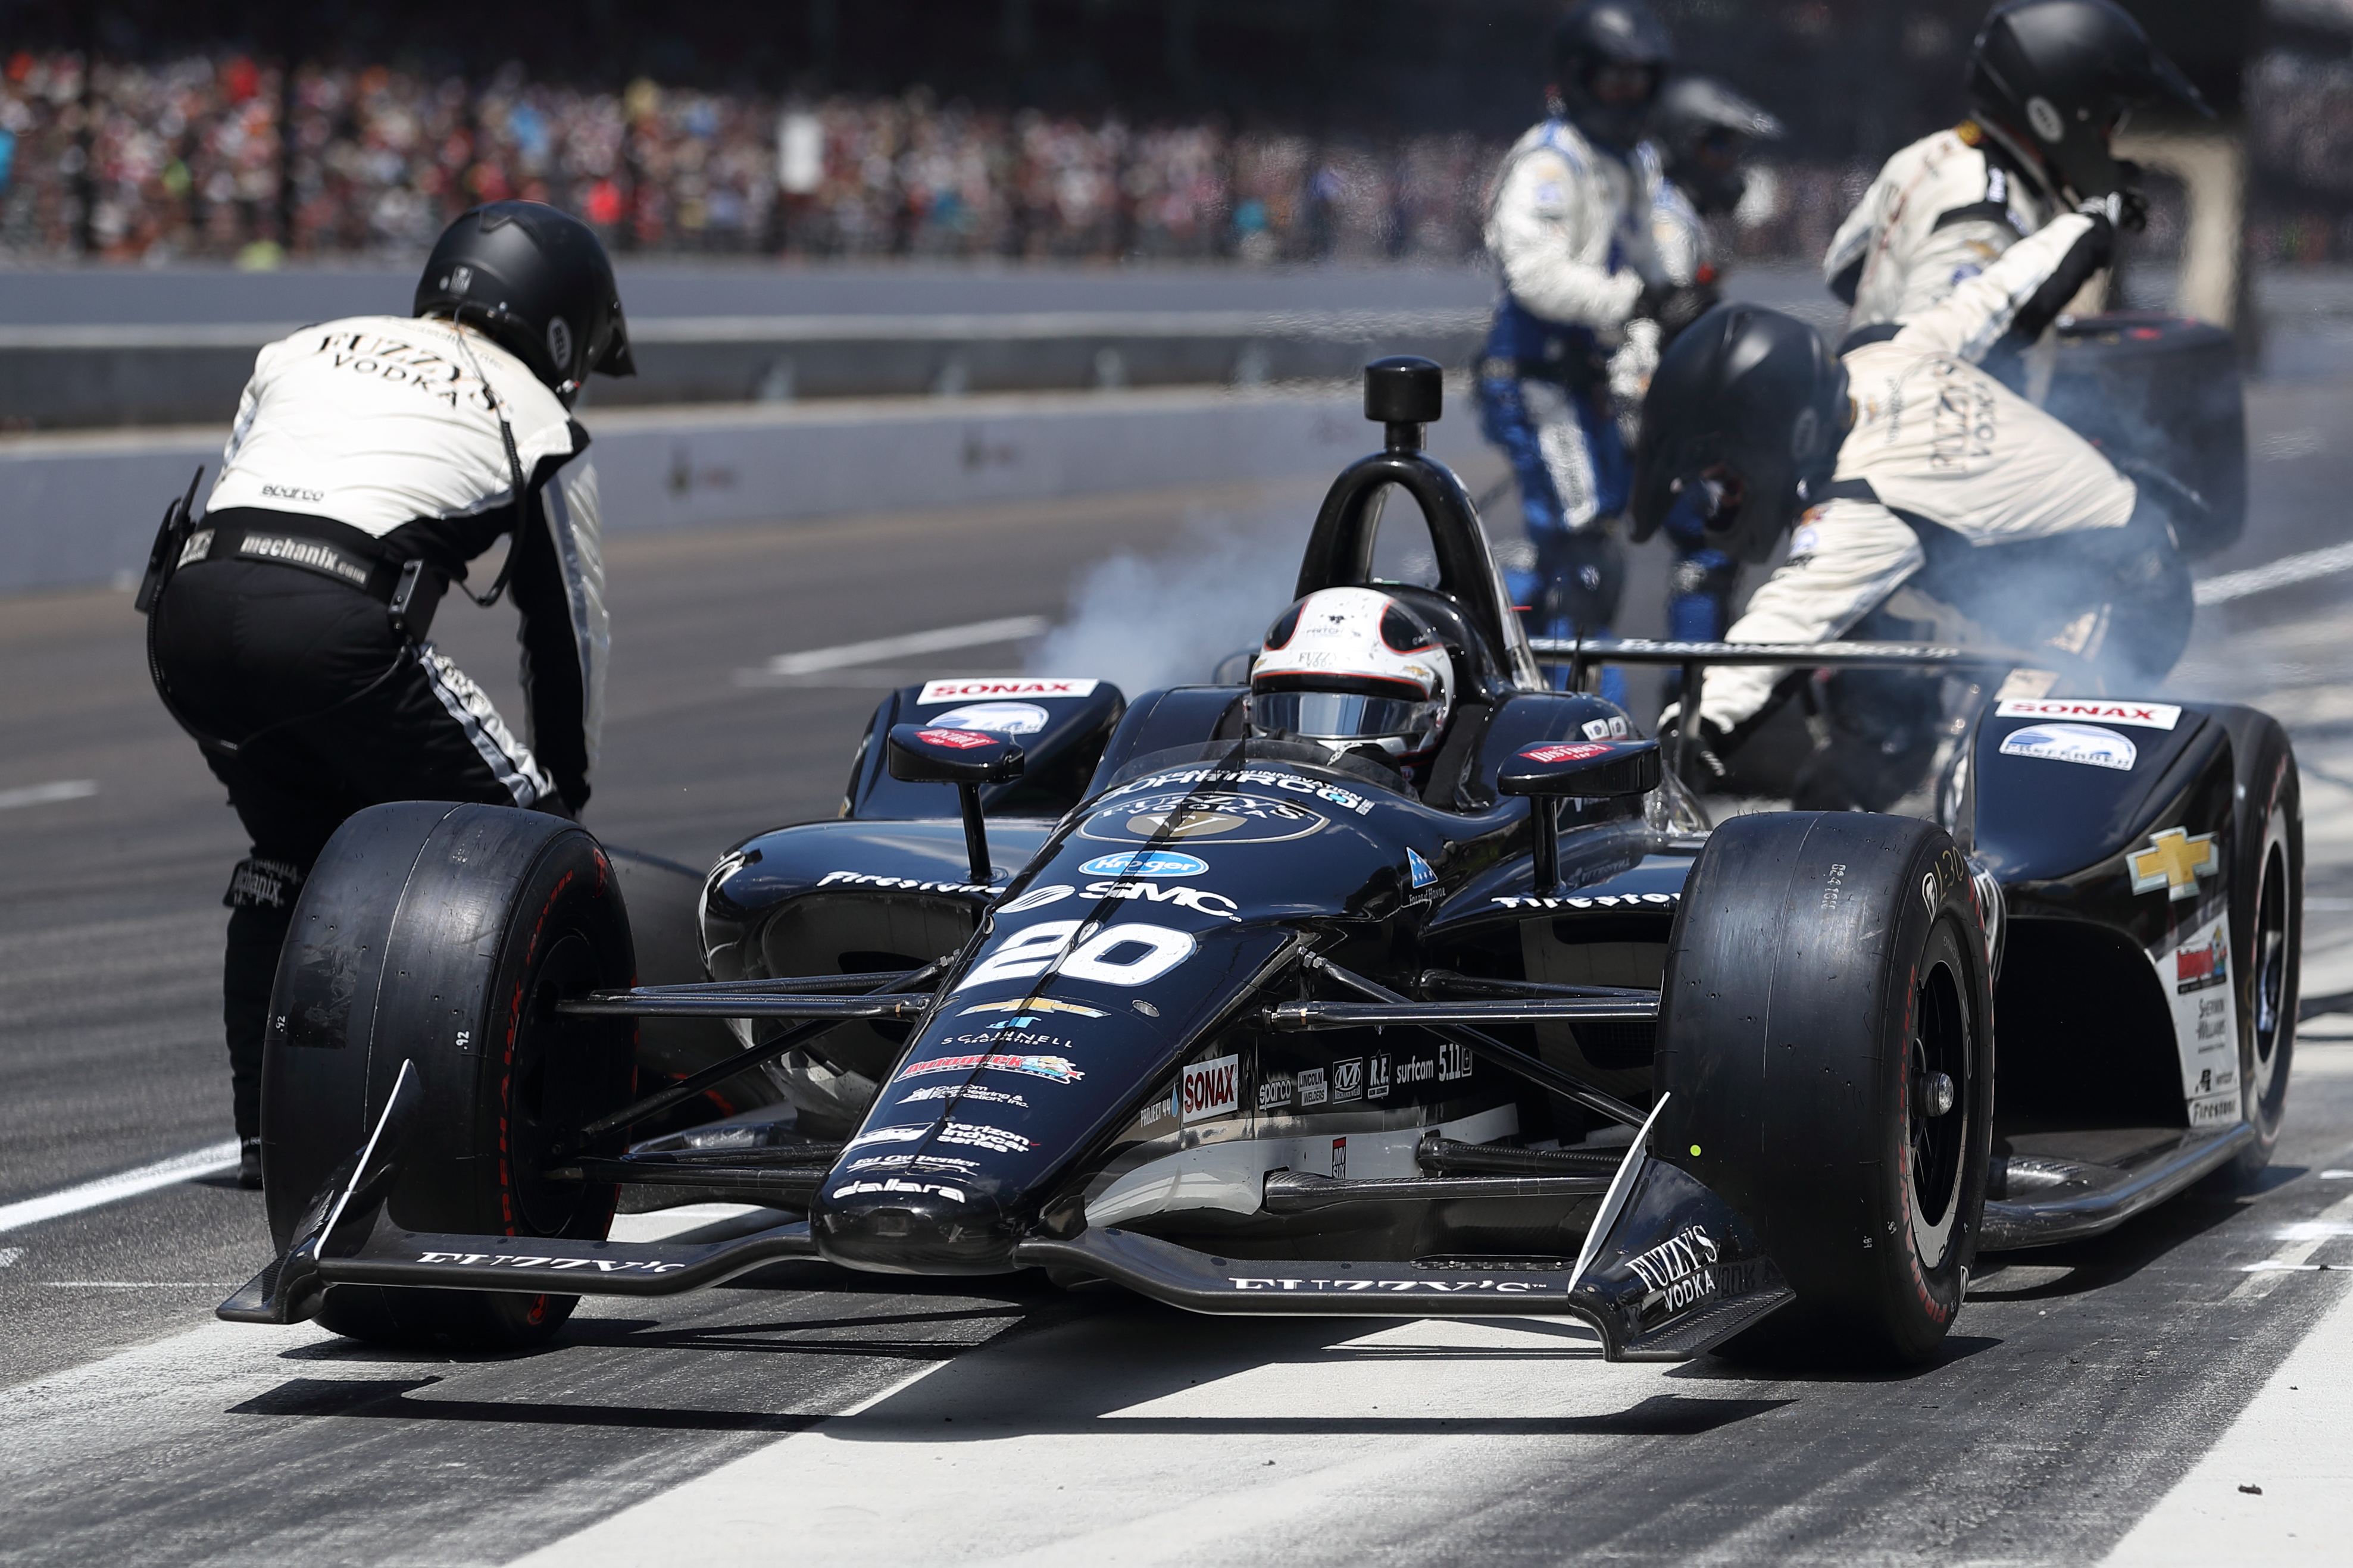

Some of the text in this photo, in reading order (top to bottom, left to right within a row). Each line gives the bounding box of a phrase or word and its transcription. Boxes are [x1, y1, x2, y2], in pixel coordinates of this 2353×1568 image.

[332, 353, 457, 409] VODKA
[261, 484, 324, 502] sparco
[932, 683, 1074, 696] SONAX
[2011, 703, 2158, 720] SONAX
[1257, 771, 1363, 800] INNOVATION
[1096, 856, 1196, 873] Kroger
[816, 871, 1007, 893] Firestone
[1079, 881, 1239, 916] SMC
[1491, 893, 1680, 908] Firesto
[952, 919, 1197, 987] 20
[276, 1015, 286, 1032] .92
[455, 1030, 470, 1050] .92
[941, 1031, 1073, 1048] SCANNELL
[904, 1054, 1024, 1075] Autogeek
[1396, 1055, 1434, 1084] surfcam
[1439, 1043, 1461, 1082] 5.11
[1184, 1064, 1235, 1114] SONAX
[1299, 1071, 1323, 1088] LINCOLN
[1007, 1098, 1029, 1111] Inc.
[1259, 1079, 1292, 1110] sparco
[1303, 1089, 1326, 1104] WELDERS
[499, 978, 522, 1237] IREHAWK
[1140, 1098, 1171, 1128] PROJECT 44
[936, 1135, 1008, 1153] series
[942, 1128, 1030, 1153] indycar
[945, 1122, 1030, 1146] verizon
[1333, 1146, 1346, 1166] JMV
[1333, 1163, 1345, 1179] SUX
[833, 1178, 966, 1203] dallara
[1898, 1139, 1948, 1324] FIREHAWK
[1626, 1225, 1719, 1294] FUZZY'S
[1662, 1269, 1716, 1312] VODKA
